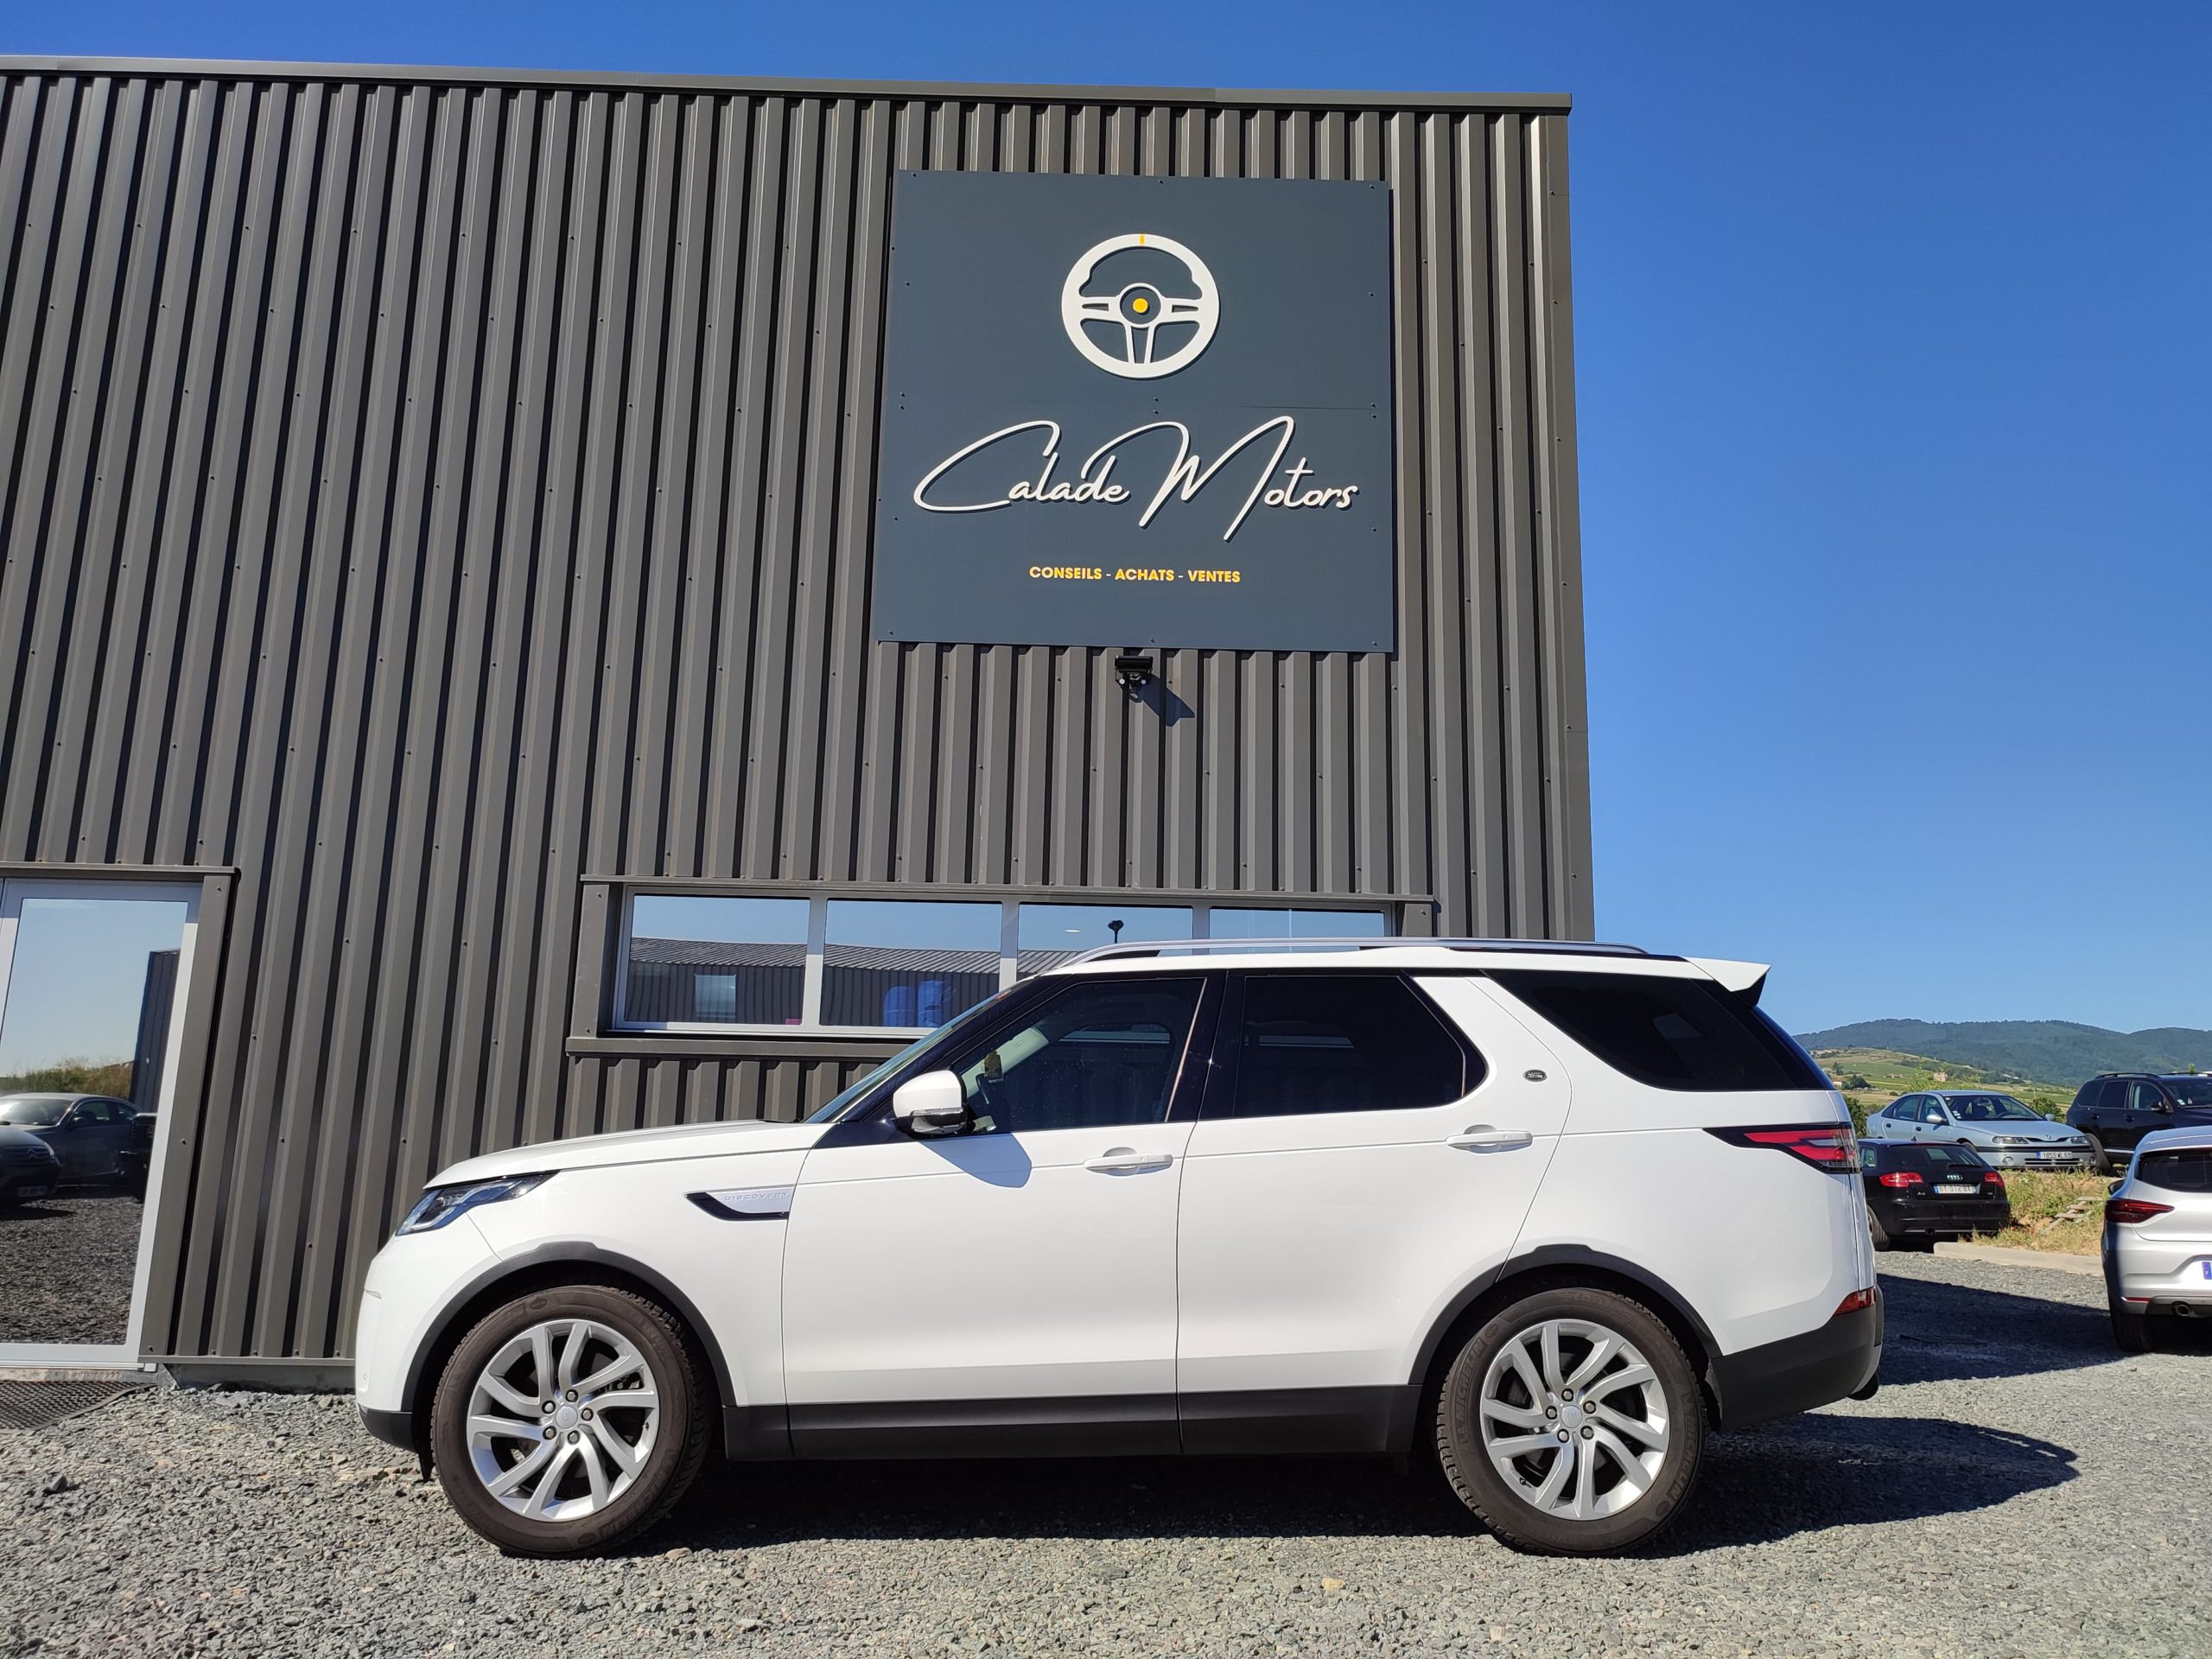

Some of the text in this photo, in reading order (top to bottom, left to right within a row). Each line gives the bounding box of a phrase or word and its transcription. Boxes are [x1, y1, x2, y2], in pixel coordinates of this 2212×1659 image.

[913, 416, 1358, 541] Calade Motors
[1029, 566, 1103, 580] CONSEILS
[1115, 569, 1175, 582] ACHATS
[1187, 569, 1242, 583] VENTES
[725, 1192, 790, 1202] DISCOVERY
[1454, 1337, 1486, 1418] MICHELIN
